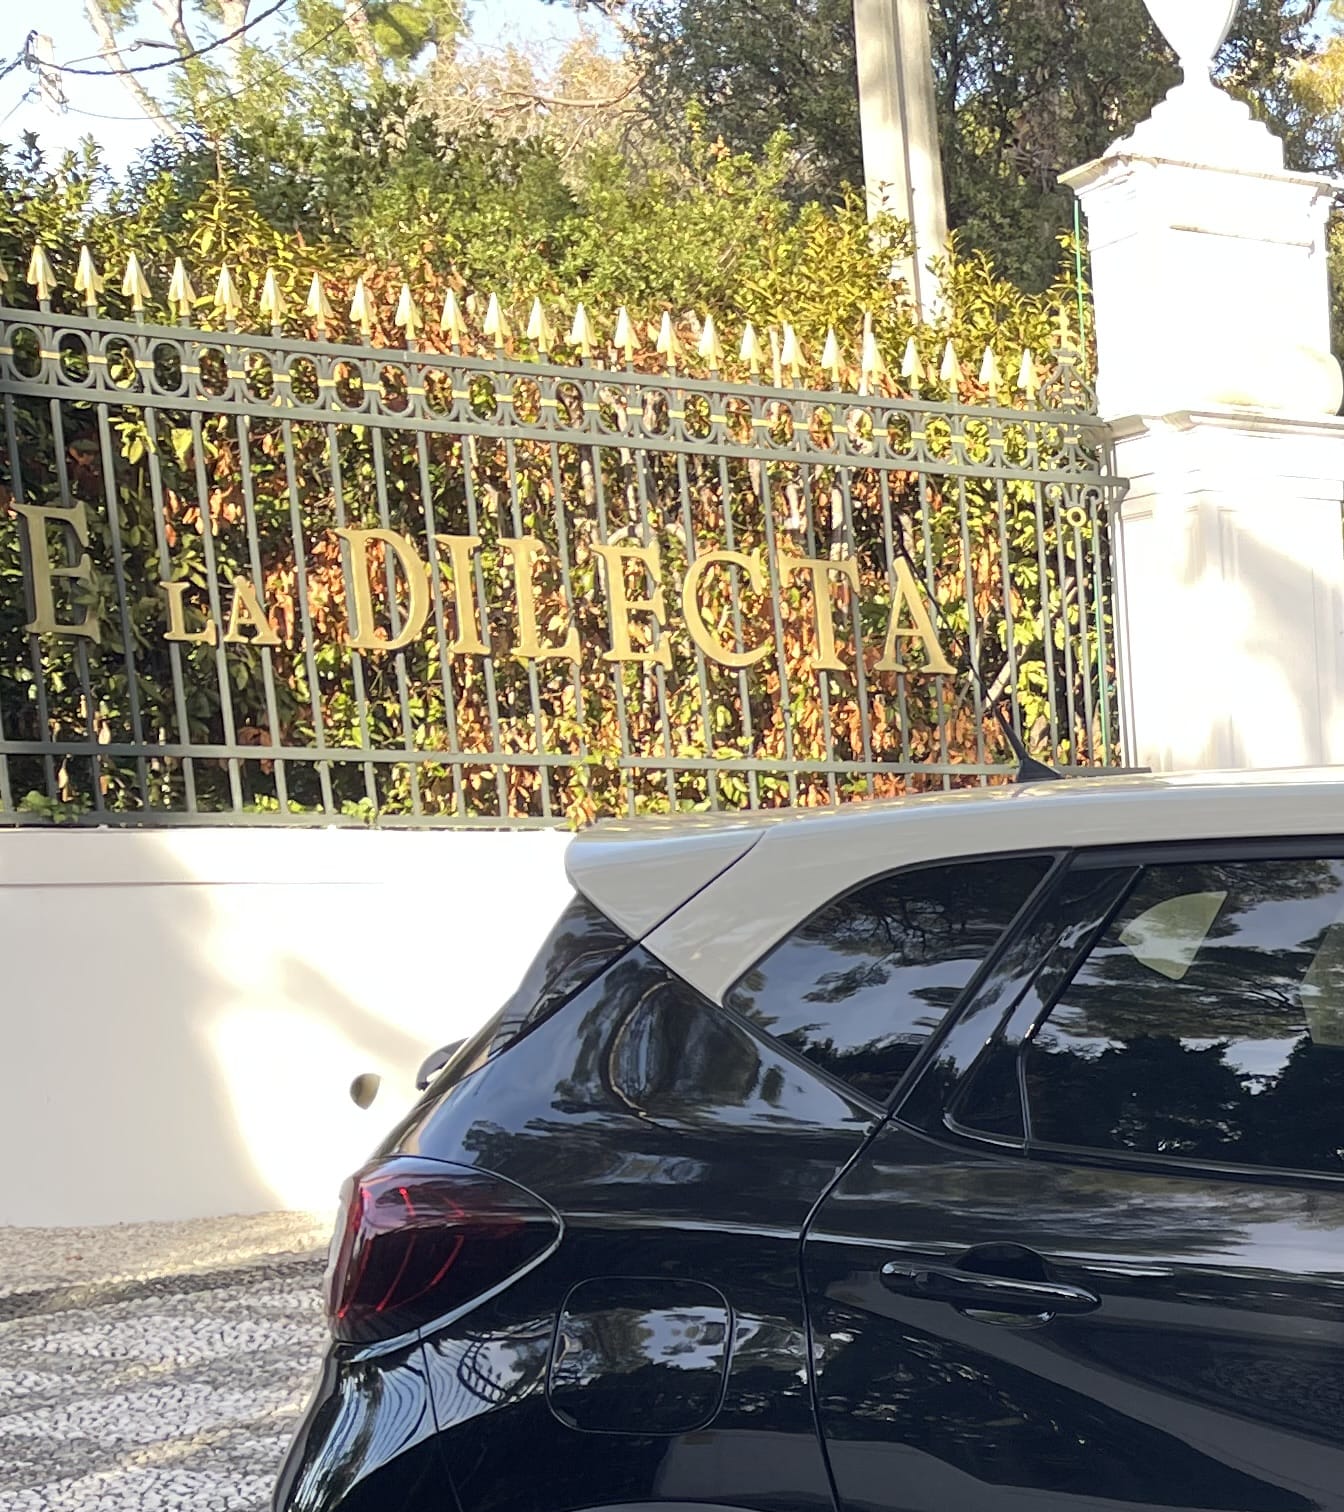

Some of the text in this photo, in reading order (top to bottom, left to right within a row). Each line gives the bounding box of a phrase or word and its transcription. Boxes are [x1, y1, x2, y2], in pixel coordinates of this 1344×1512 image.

[10, 502, 957, 675] E LA DILECTA
